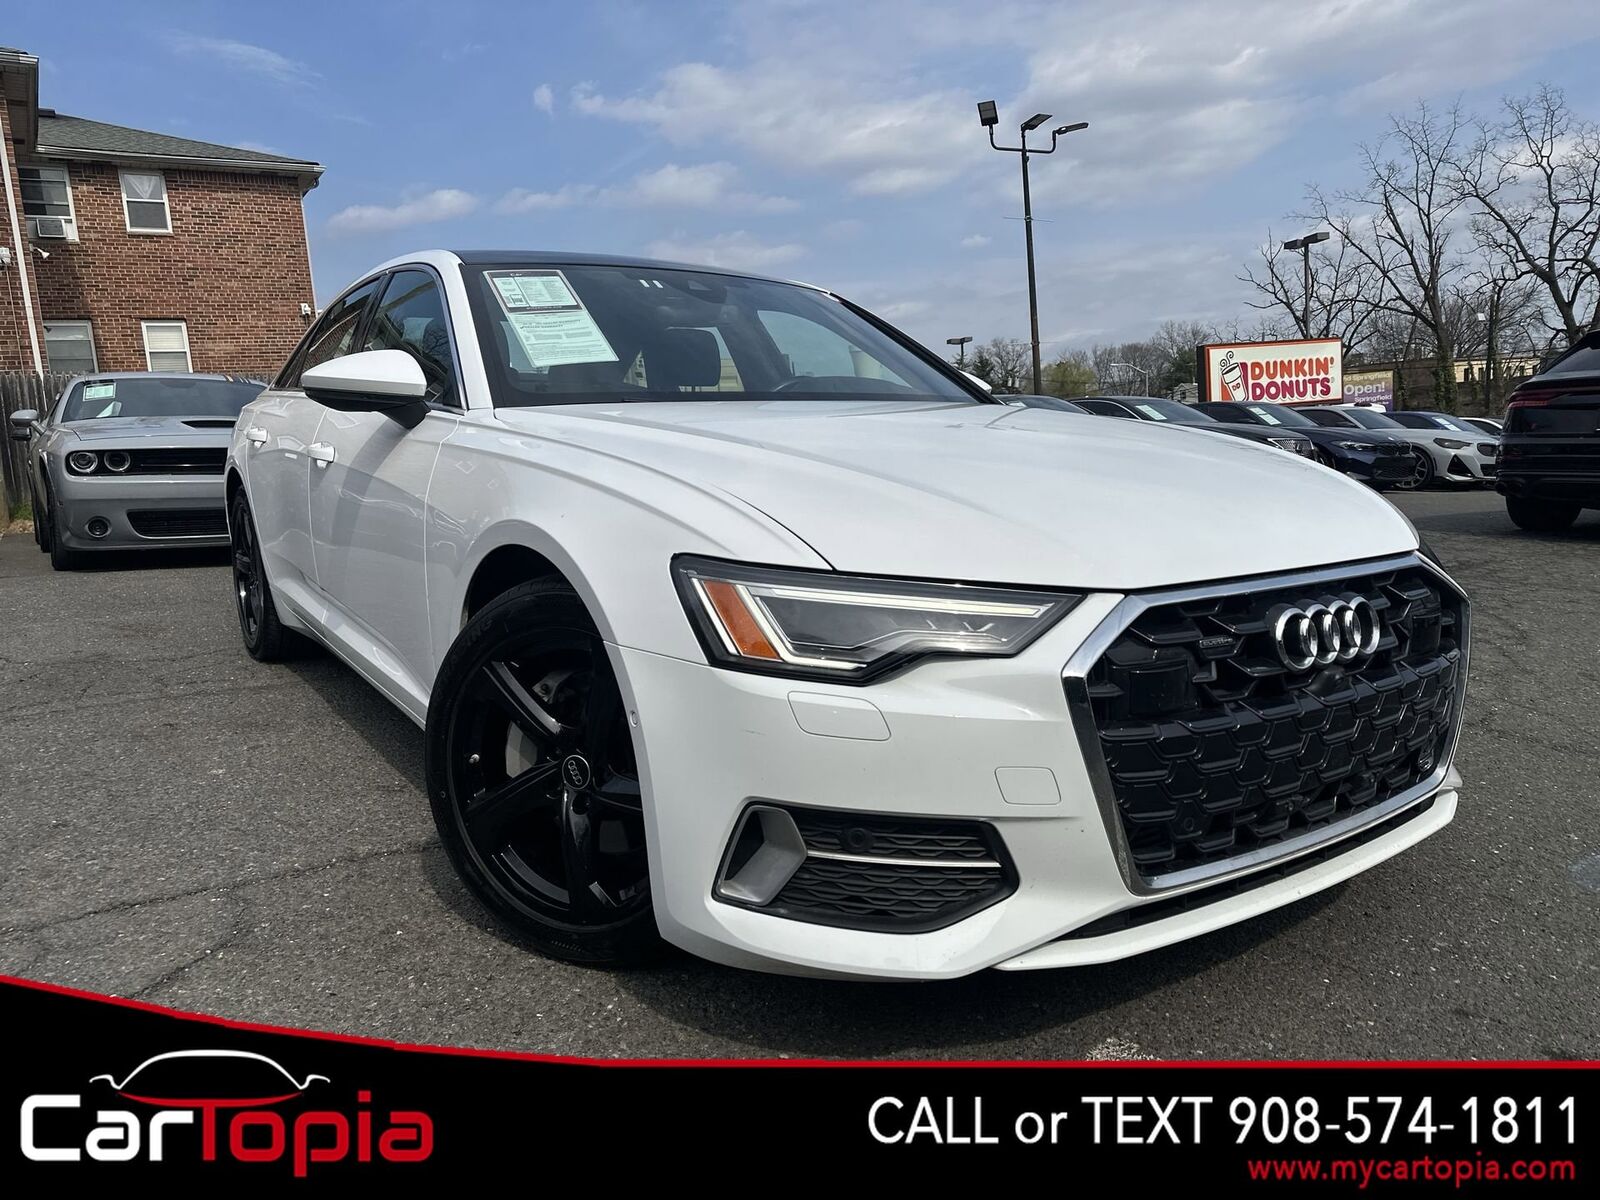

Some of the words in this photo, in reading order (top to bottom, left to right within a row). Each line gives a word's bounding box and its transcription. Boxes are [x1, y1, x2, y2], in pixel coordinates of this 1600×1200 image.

[1250, 357, 1334, 381] DUNKIN'
[1251, 377, 1331, 401] DONUTS
[1344, 381, 1385, 397] Open!
[1354, 394, 1392, 403] Springfield
